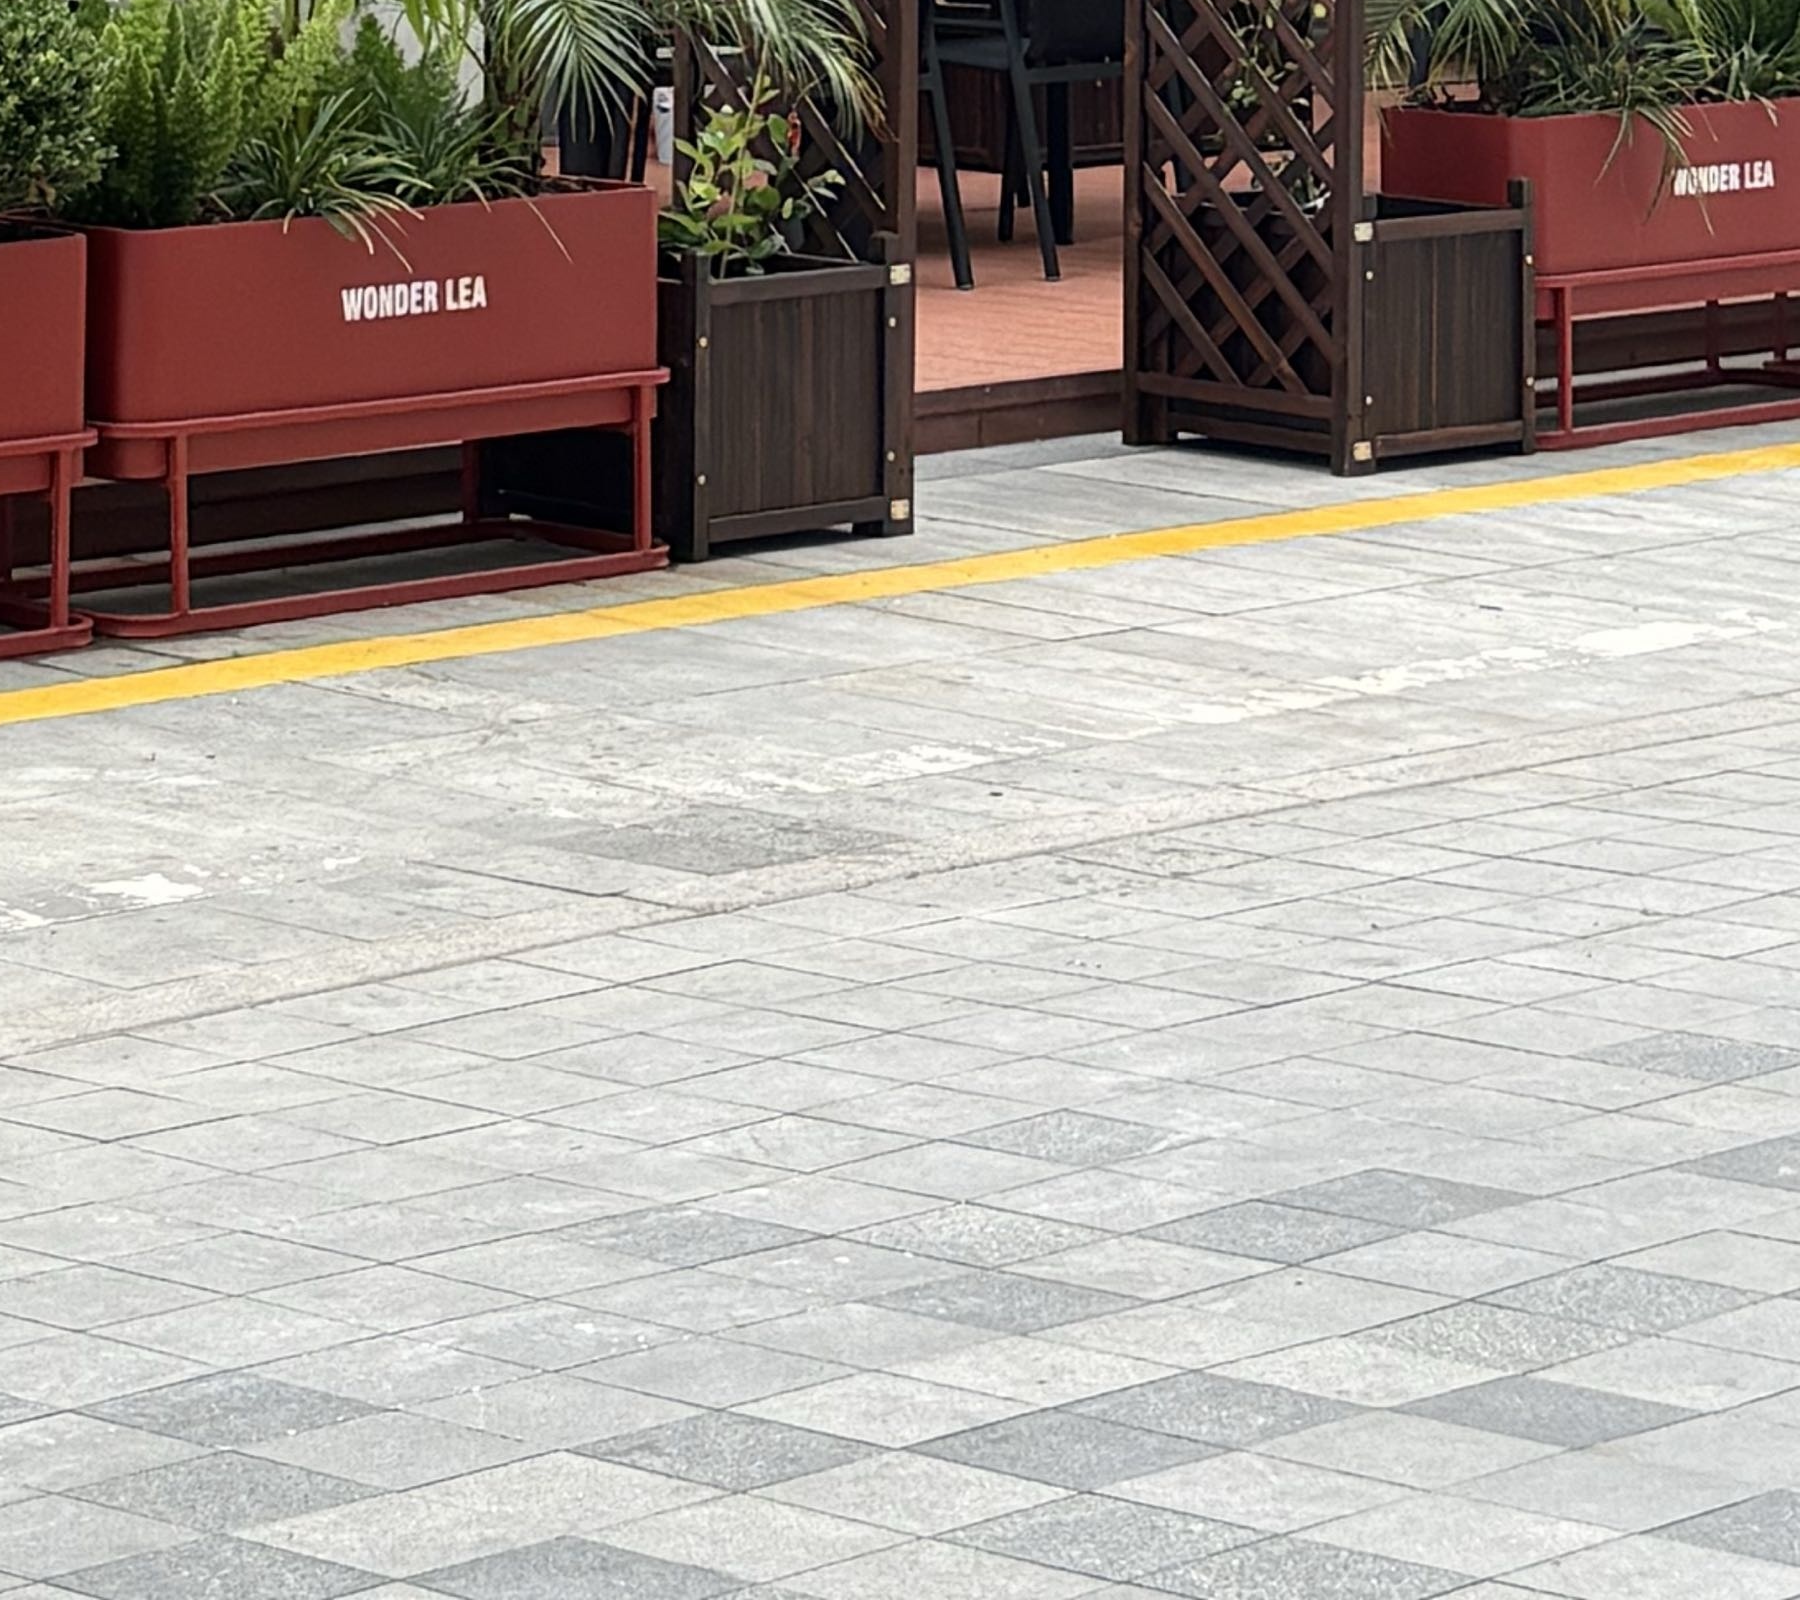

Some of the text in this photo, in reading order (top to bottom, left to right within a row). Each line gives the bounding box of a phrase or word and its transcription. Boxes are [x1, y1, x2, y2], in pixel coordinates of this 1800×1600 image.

[1744, 160, 1775, 189] LEA
[341, 275, 487, 322] WONDER LEA
